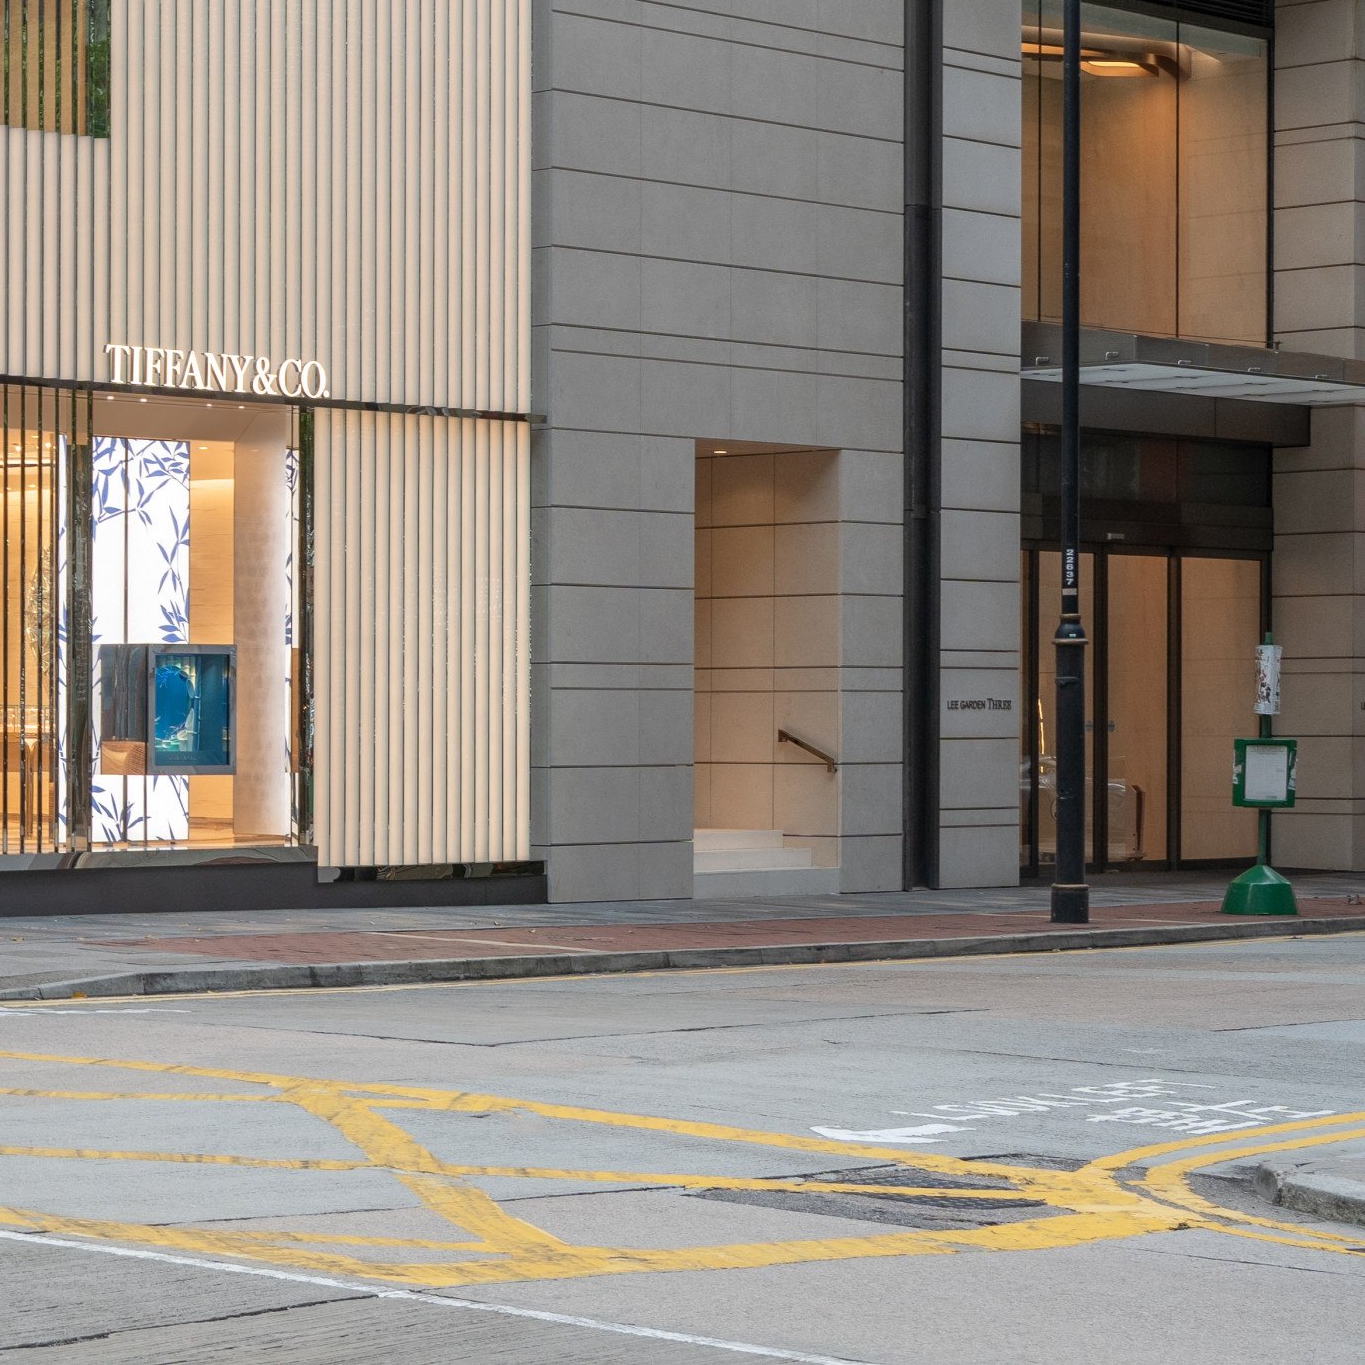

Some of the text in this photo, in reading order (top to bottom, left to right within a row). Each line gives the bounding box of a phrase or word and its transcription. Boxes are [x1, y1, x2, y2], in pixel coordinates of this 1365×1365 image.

[104, 343, 330, 399] TIFFANY&CO.
[1066, 548, 1074, 586] 22637
[947, 697, 1012, 710] LEE GARDEN THREE
[889, 1078, 1216, 1121] LOOK LEFT
